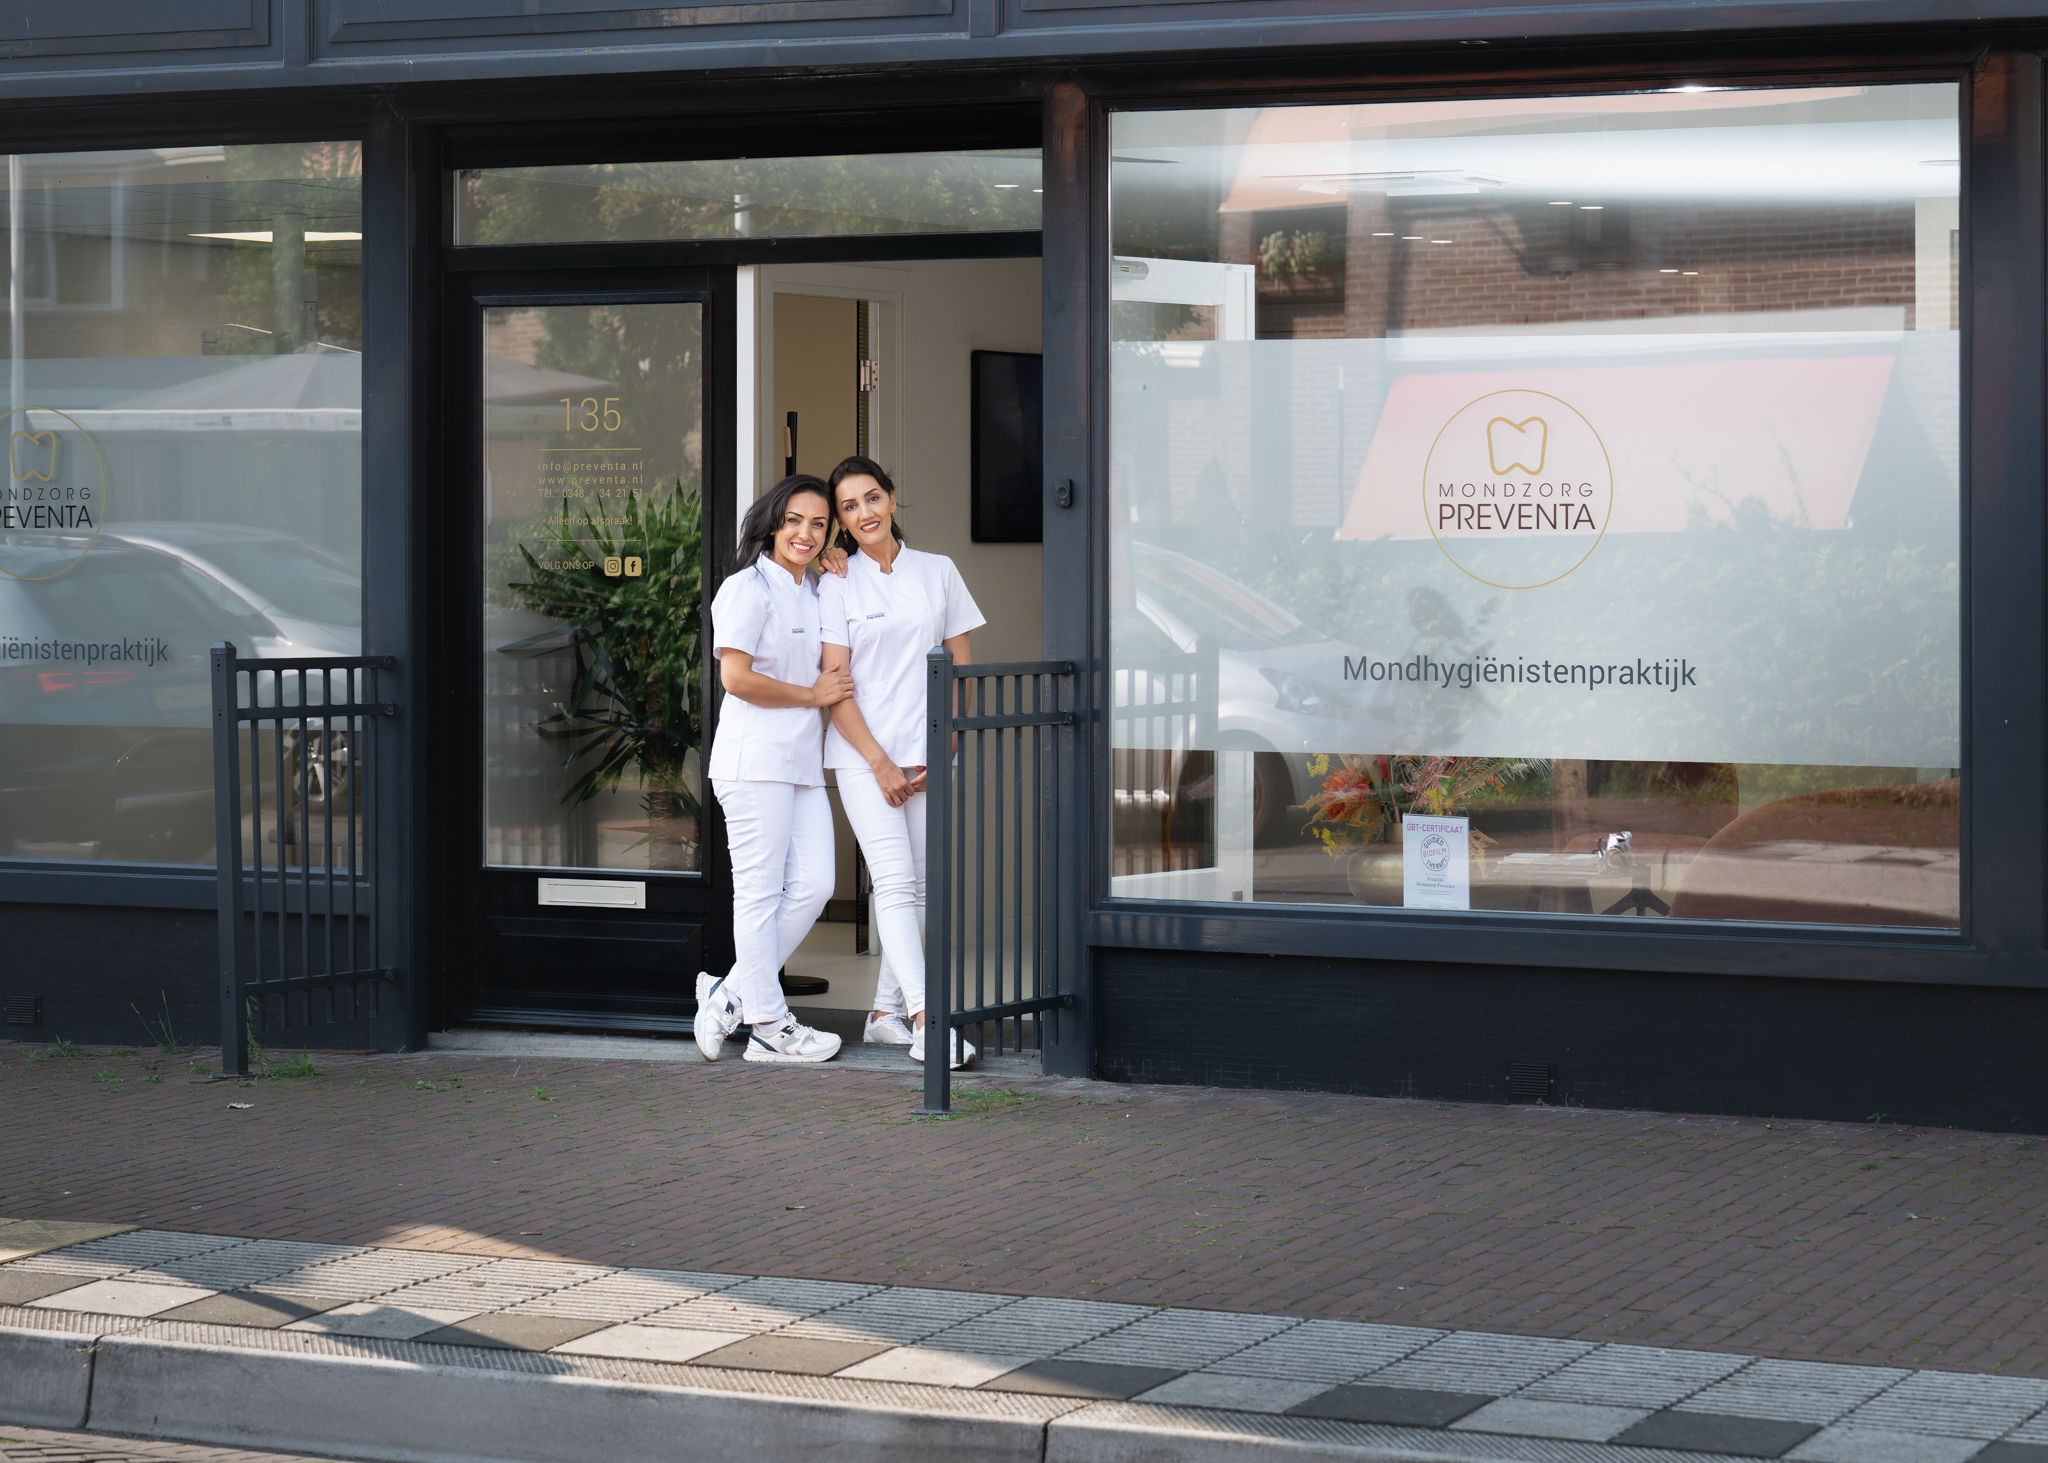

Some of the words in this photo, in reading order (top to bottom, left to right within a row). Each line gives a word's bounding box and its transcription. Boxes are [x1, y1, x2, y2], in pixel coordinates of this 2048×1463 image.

[560, 397, 621, 431] 135
[538, 461, 643, 473] info@preventa.nl
[538, 474, 643, 486] www.preventa.nl
[0, 487, 91, 500] NDZORG
[562, 488, 585, 498] 0348
[599, 488, 611, 498] 34
[616, 488, 627, 498] 21
[632, 488, 643, 498] 51
[1438, 483, 1594, 498] MONDZORG
[0, 504, 93, 529] EVENTA
[547, 516, 575, 526] Alleen
[577, 518, 589, 527] op
[590, 515, 633, 527] afspraak!
[1438, 503, 1597, 530] PREVENTA
[538, 561, 561, 570] VOLG
[562, 561, 581, 570] ONS
[582, 561, 595, 570] OP
[0, 636, 168, 667] iënistenpraktijk
[1343, 655, 1697, 693] Mondhygiënistenpraktijk
[1407, 823, 1463, 834] GBT-CERTIFICAAT
[1424, 836, 1444, 849] GUIDED
[1423, 848, 1447, 858] BIOFILM
[1427, 858, 1447, 869] THERAPY
